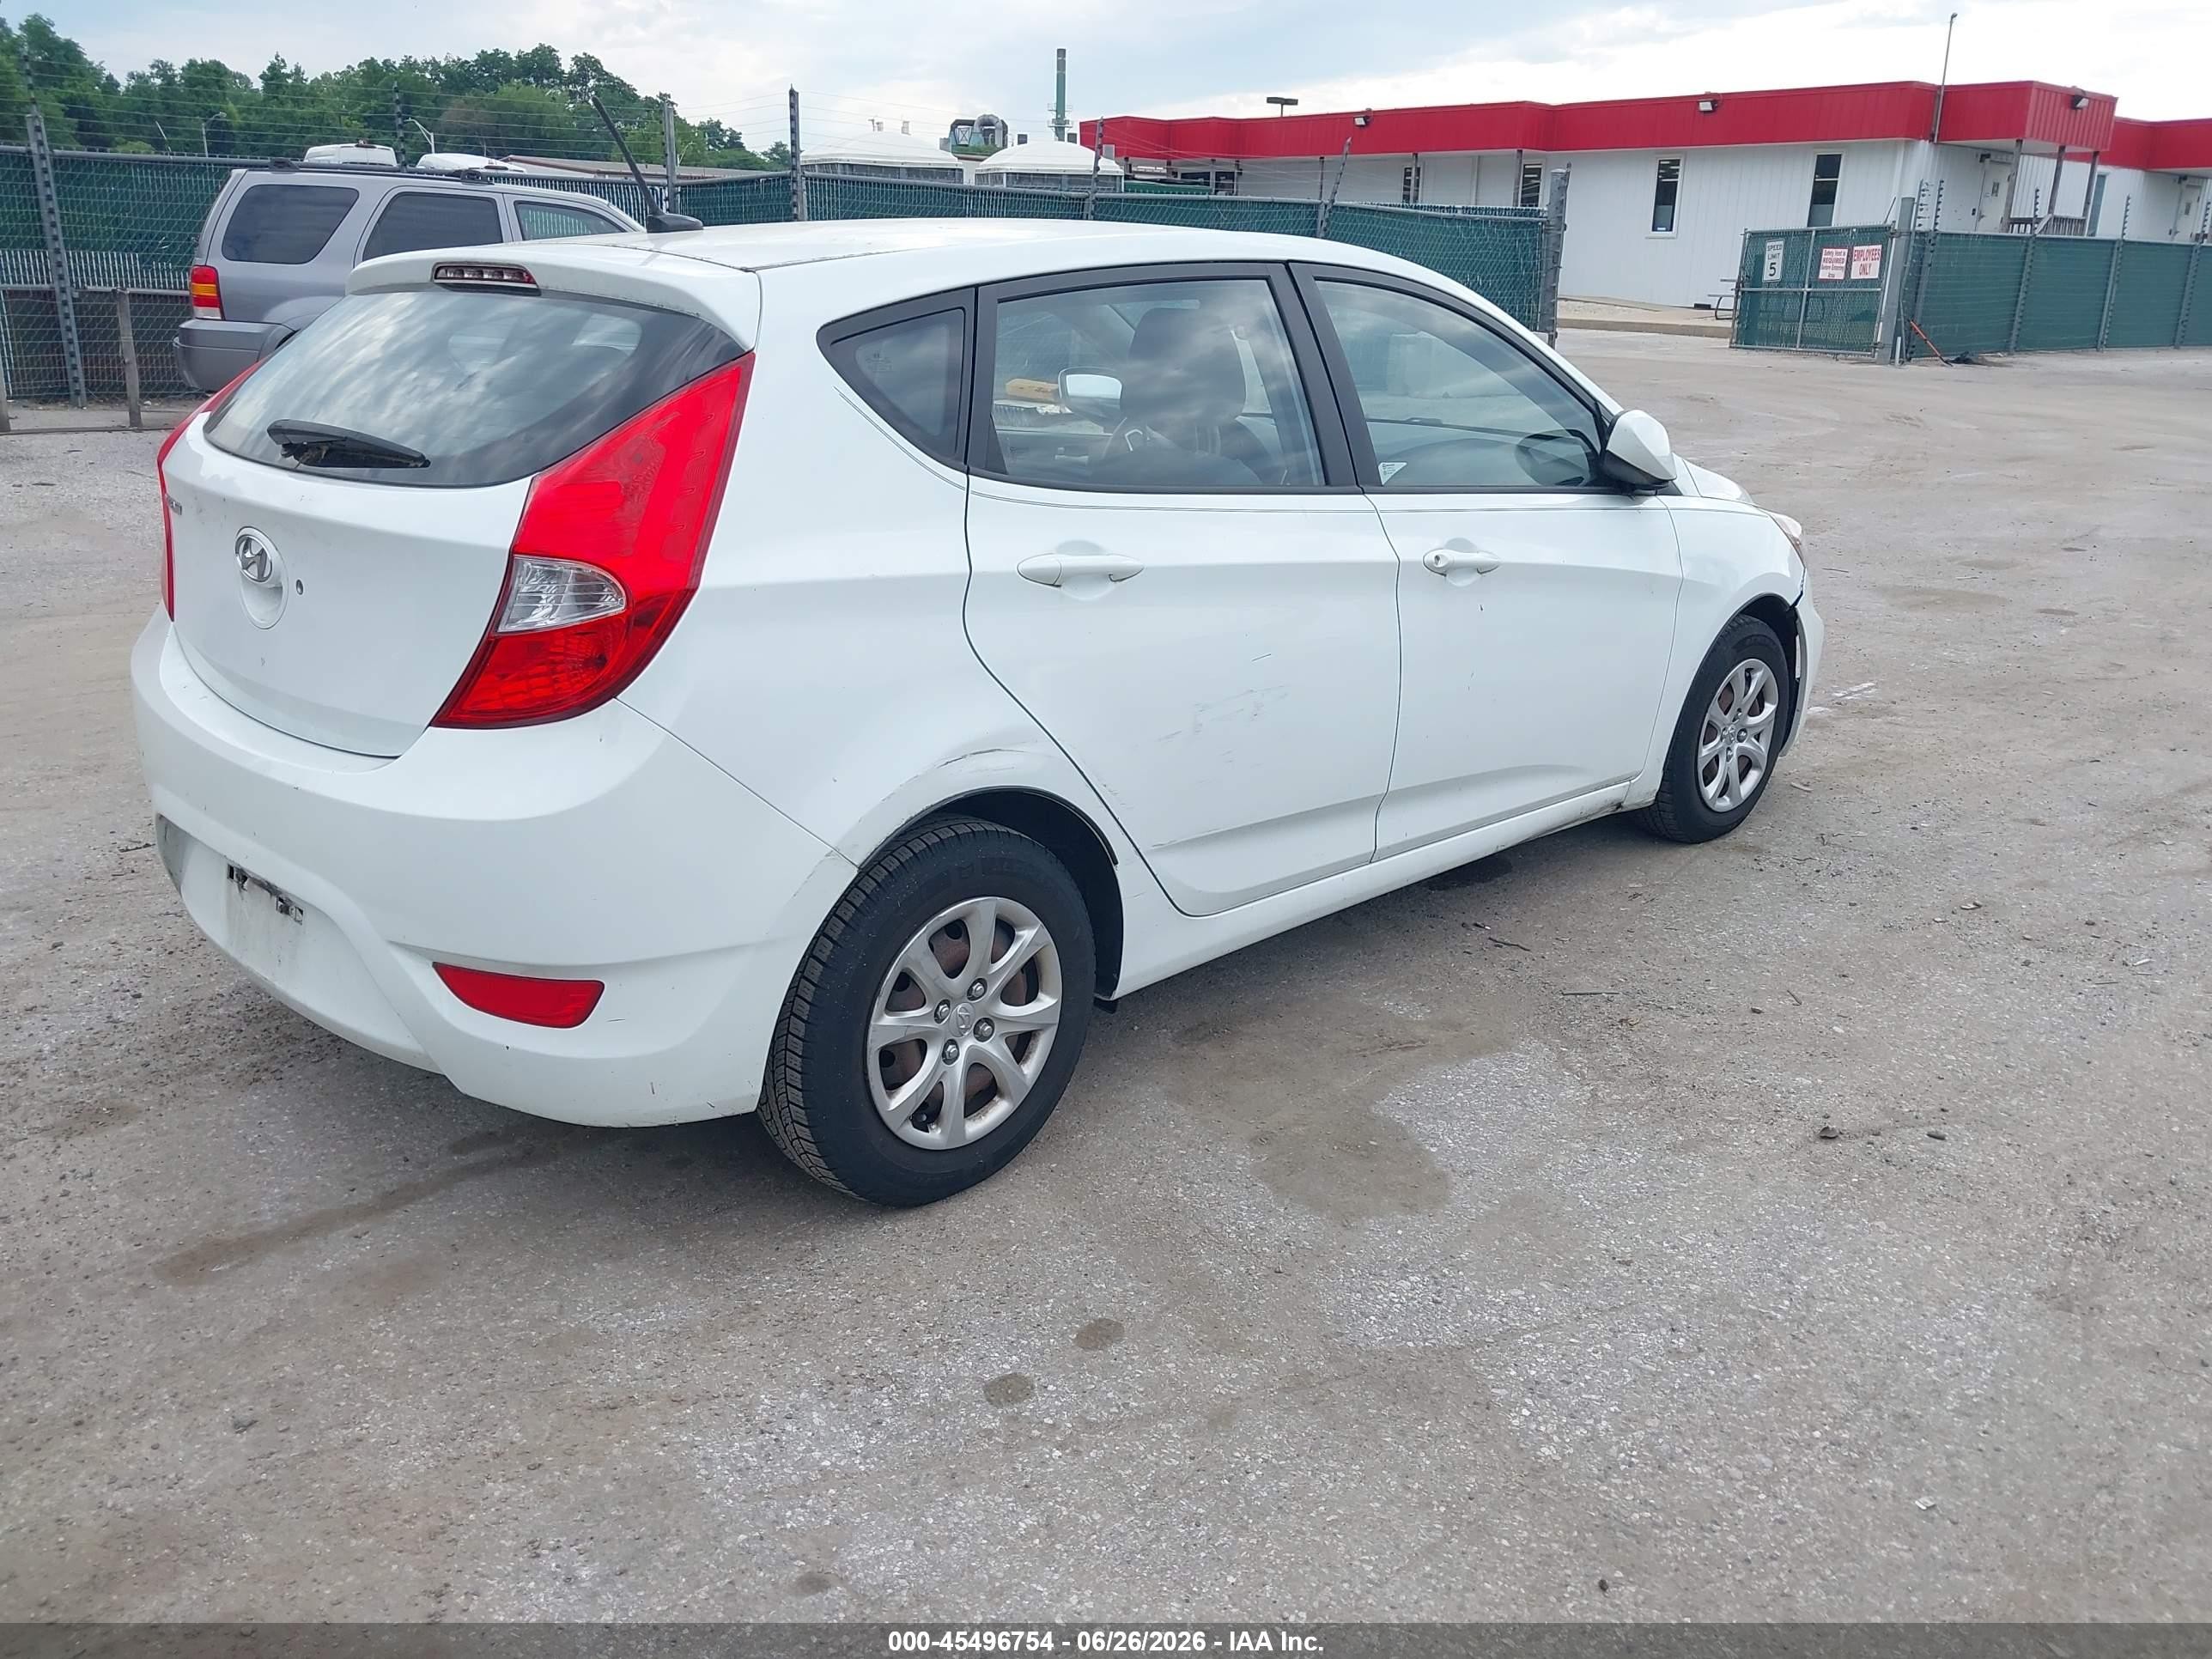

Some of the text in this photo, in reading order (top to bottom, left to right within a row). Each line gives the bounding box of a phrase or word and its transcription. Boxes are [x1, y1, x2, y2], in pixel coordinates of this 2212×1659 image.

[1854, 248, 1881, 261] EMPLOYEES
[1769, 262, 1777, 276] 5
[1859, 263, 1872, 275] ONLY
